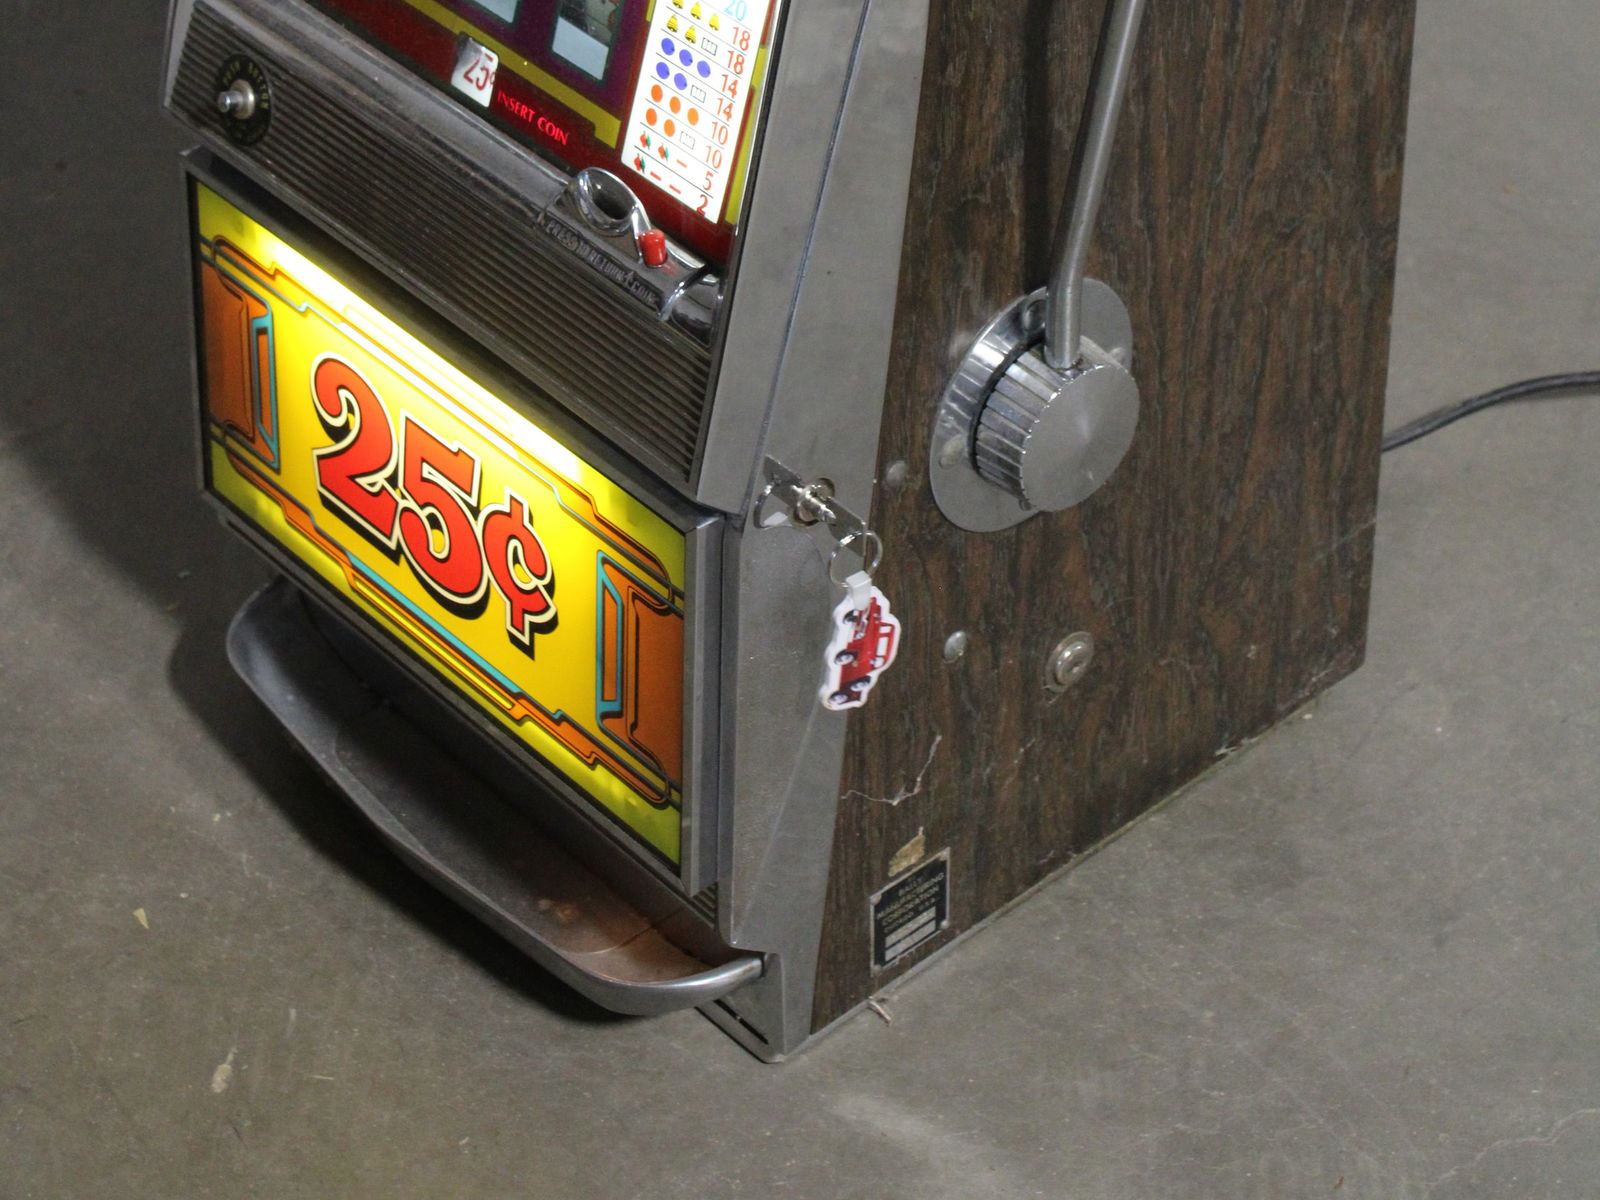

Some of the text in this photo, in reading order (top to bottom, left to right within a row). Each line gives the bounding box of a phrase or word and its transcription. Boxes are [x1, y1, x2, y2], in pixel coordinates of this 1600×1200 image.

[732, 26, 751, 52] 18
[727, 50, 745, 75] 18
[722, 74, 739, 99] 14
[497, 89, 570, 146] INSERT COIN
[717, 97, 734, 121] 14
[711, 121, 729, 145] 10
[705, 145, 723, 169] 10
[702, 170, 714, 191] 5
[696, 194, 709, 216] 2
[311, 351, 557, 654] 25¢
